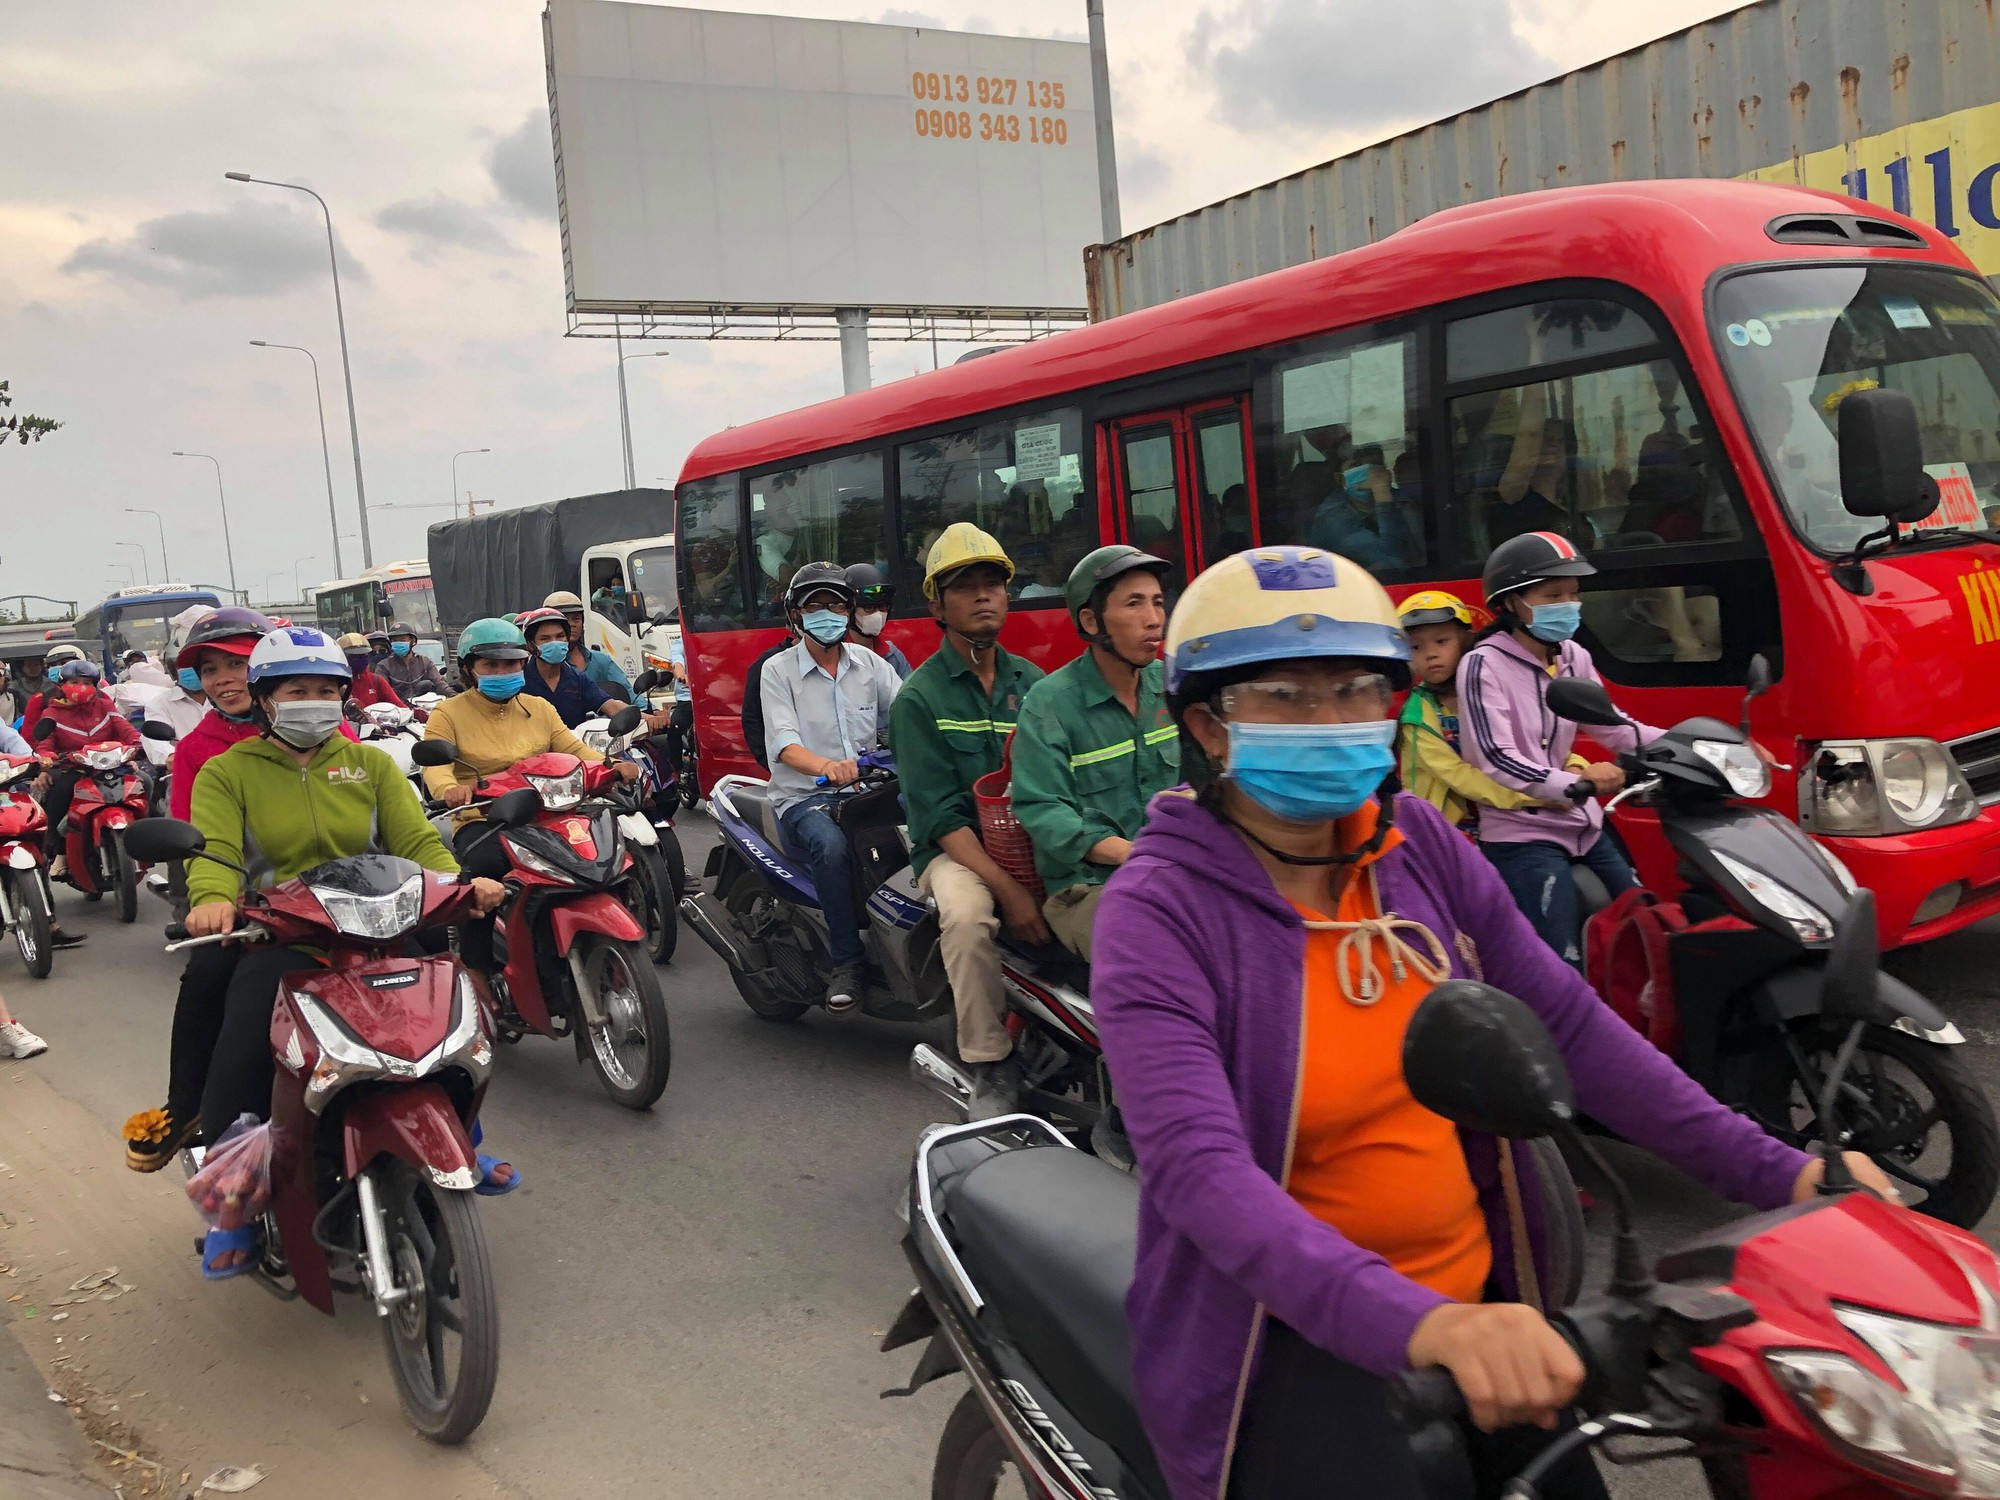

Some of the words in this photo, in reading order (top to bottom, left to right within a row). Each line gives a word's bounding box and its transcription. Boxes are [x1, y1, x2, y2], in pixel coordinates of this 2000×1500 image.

[912, 71, 969, 103] 0913
[976, 76, 1017, 105] 927
[1026, 80, 1065, 109] 135
[915, 108, 971, 139] 0908
[979, 112, 1020, 142] 343
[1029, 116, 1067, 145] 180
[327, 766, 367, 780] FILA
[741, 838, 794, 879] NOUVO
[877, 889, 905, 906] GP
[372, 975, 415, 987] HONDA
[1000, 1379, 1120, 1500] SIRIU
